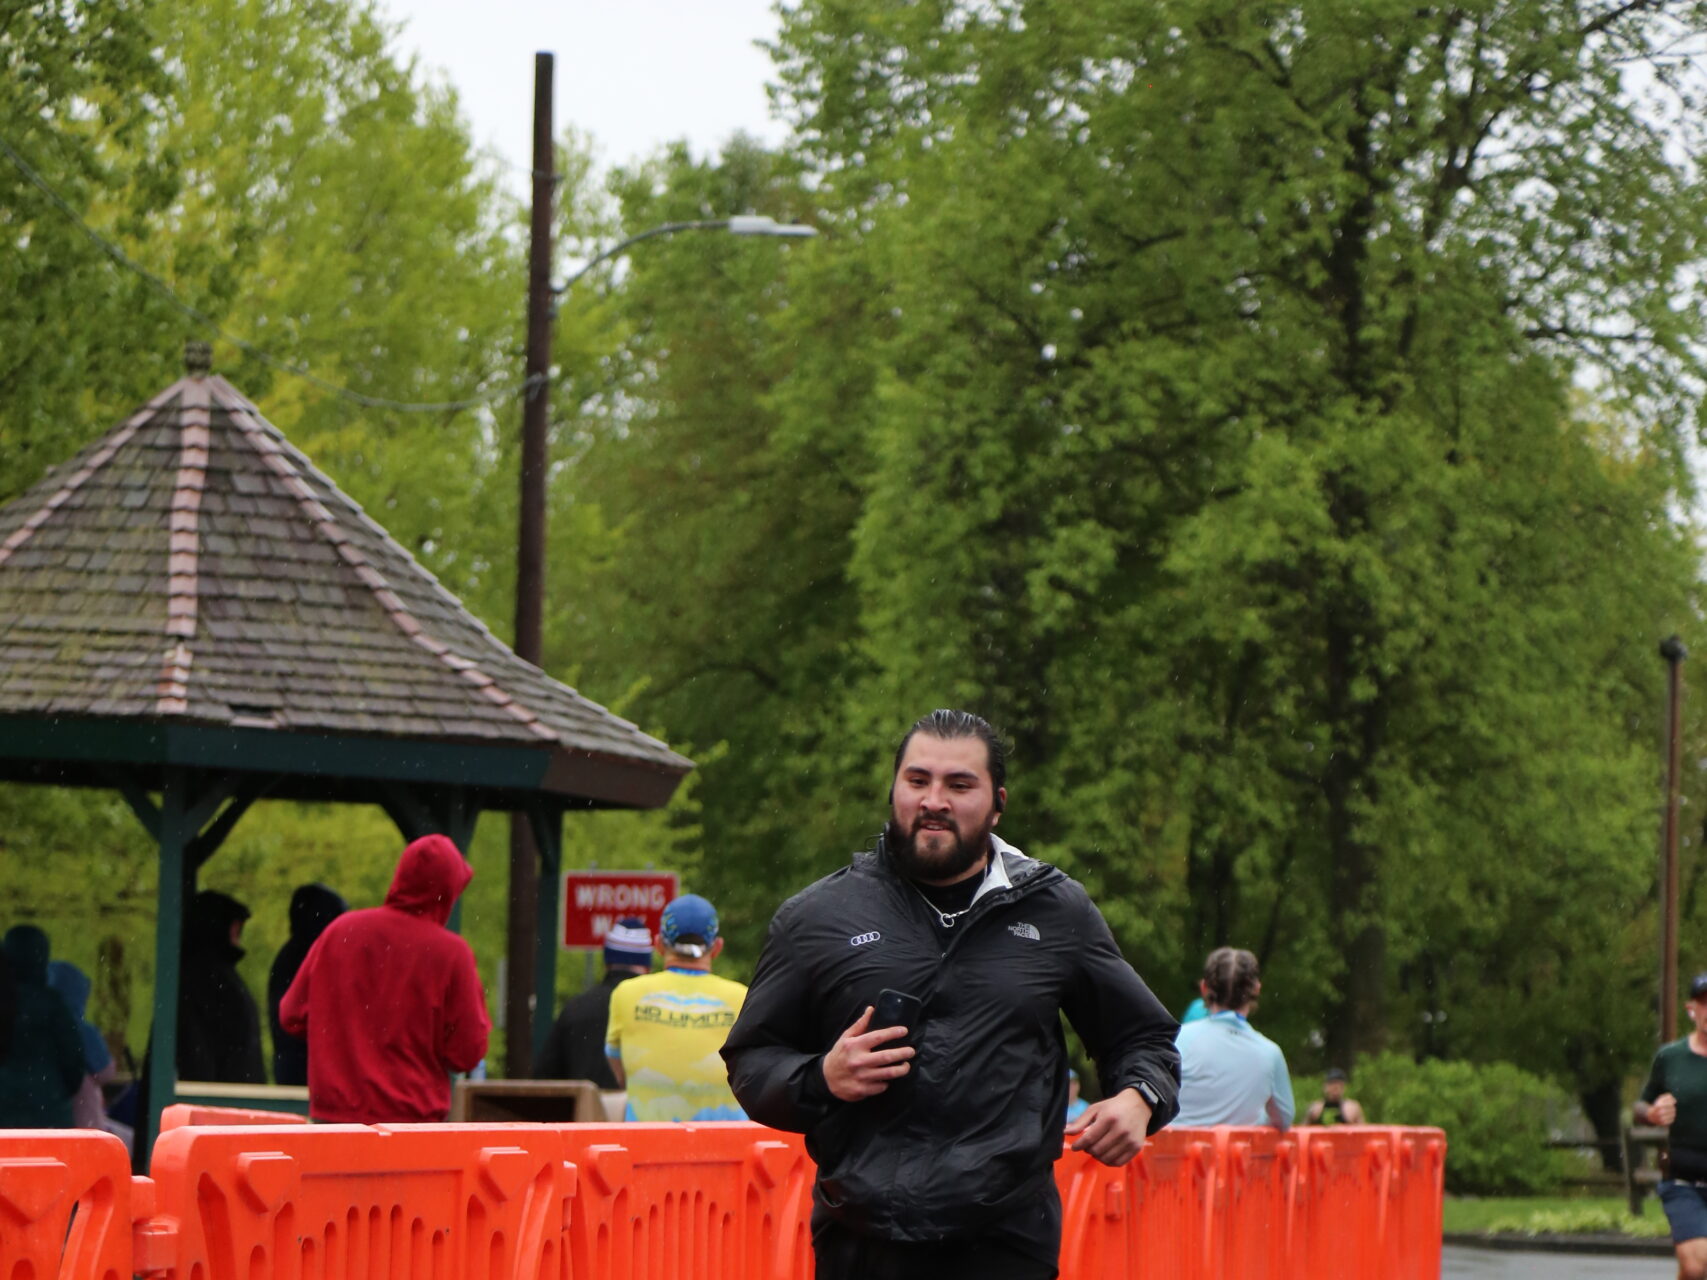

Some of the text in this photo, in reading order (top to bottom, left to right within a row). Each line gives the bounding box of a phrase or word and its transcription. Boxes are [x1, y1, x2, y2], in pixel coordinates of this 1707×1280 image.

[576, 883, 665, 910] WRONG
[635, 1005, 661, 1016] NO
[669, 1010, 736, 1023] LIMITS
